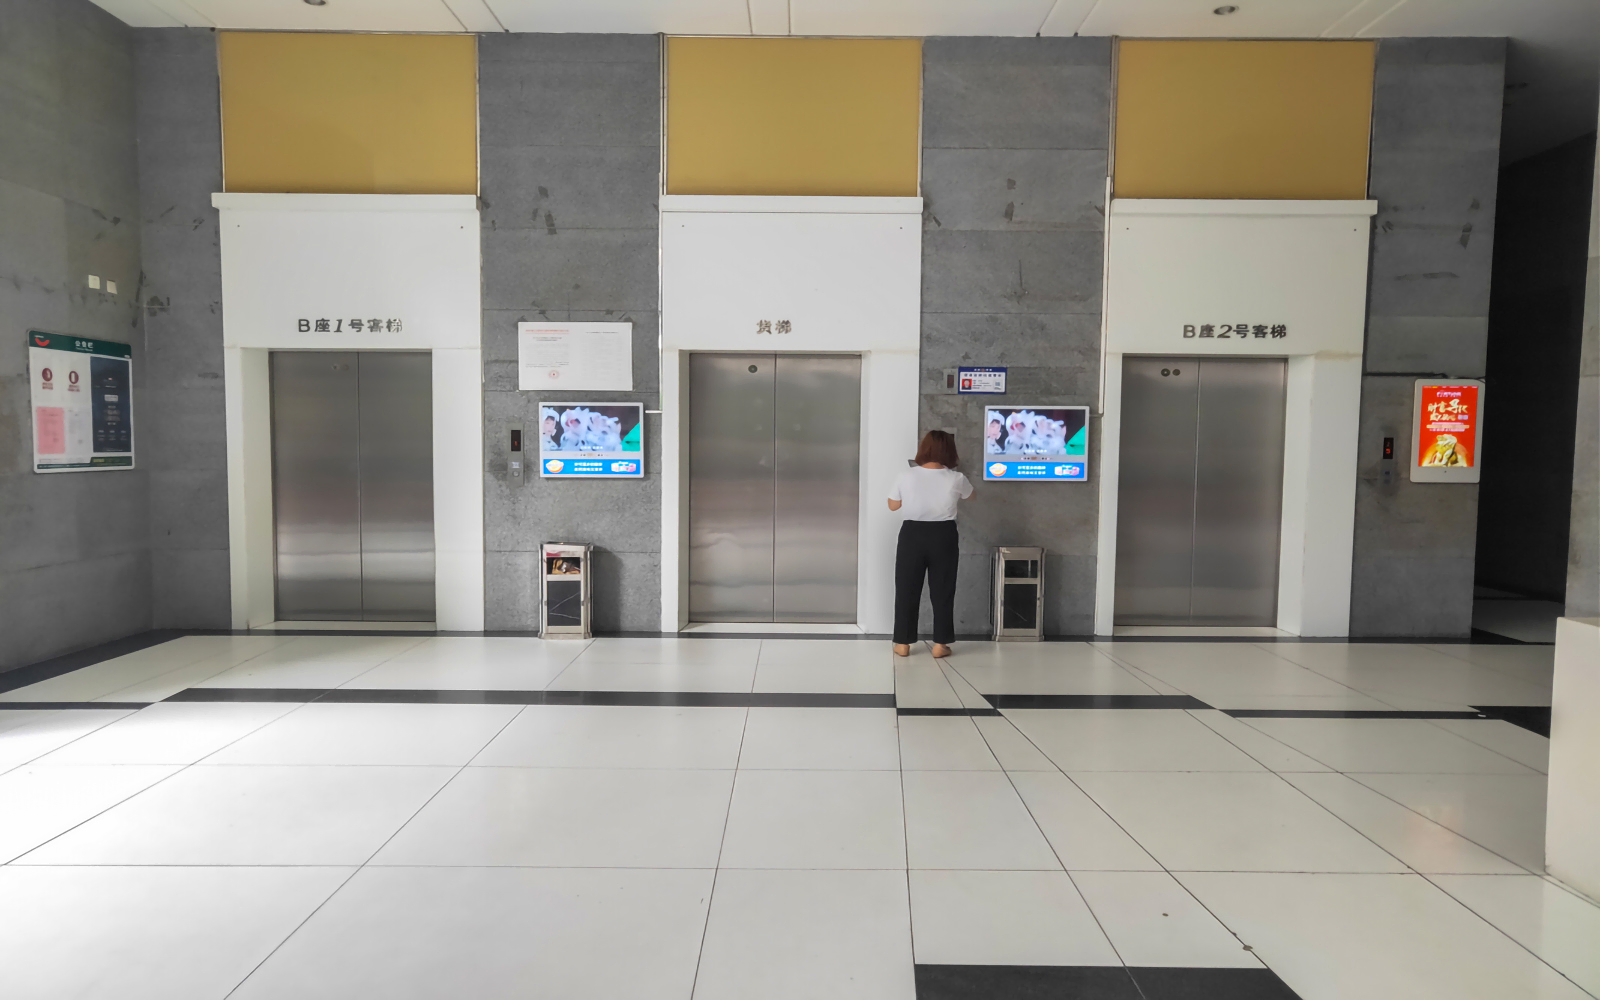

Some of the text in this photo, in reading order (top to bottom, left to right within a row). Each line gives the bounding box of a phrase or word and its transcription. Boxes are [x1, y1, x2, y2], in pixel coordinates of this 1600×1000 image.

[756, 319, 792, 335] 货梯
[1183, 323, 1287, 339] B座2号客梯
